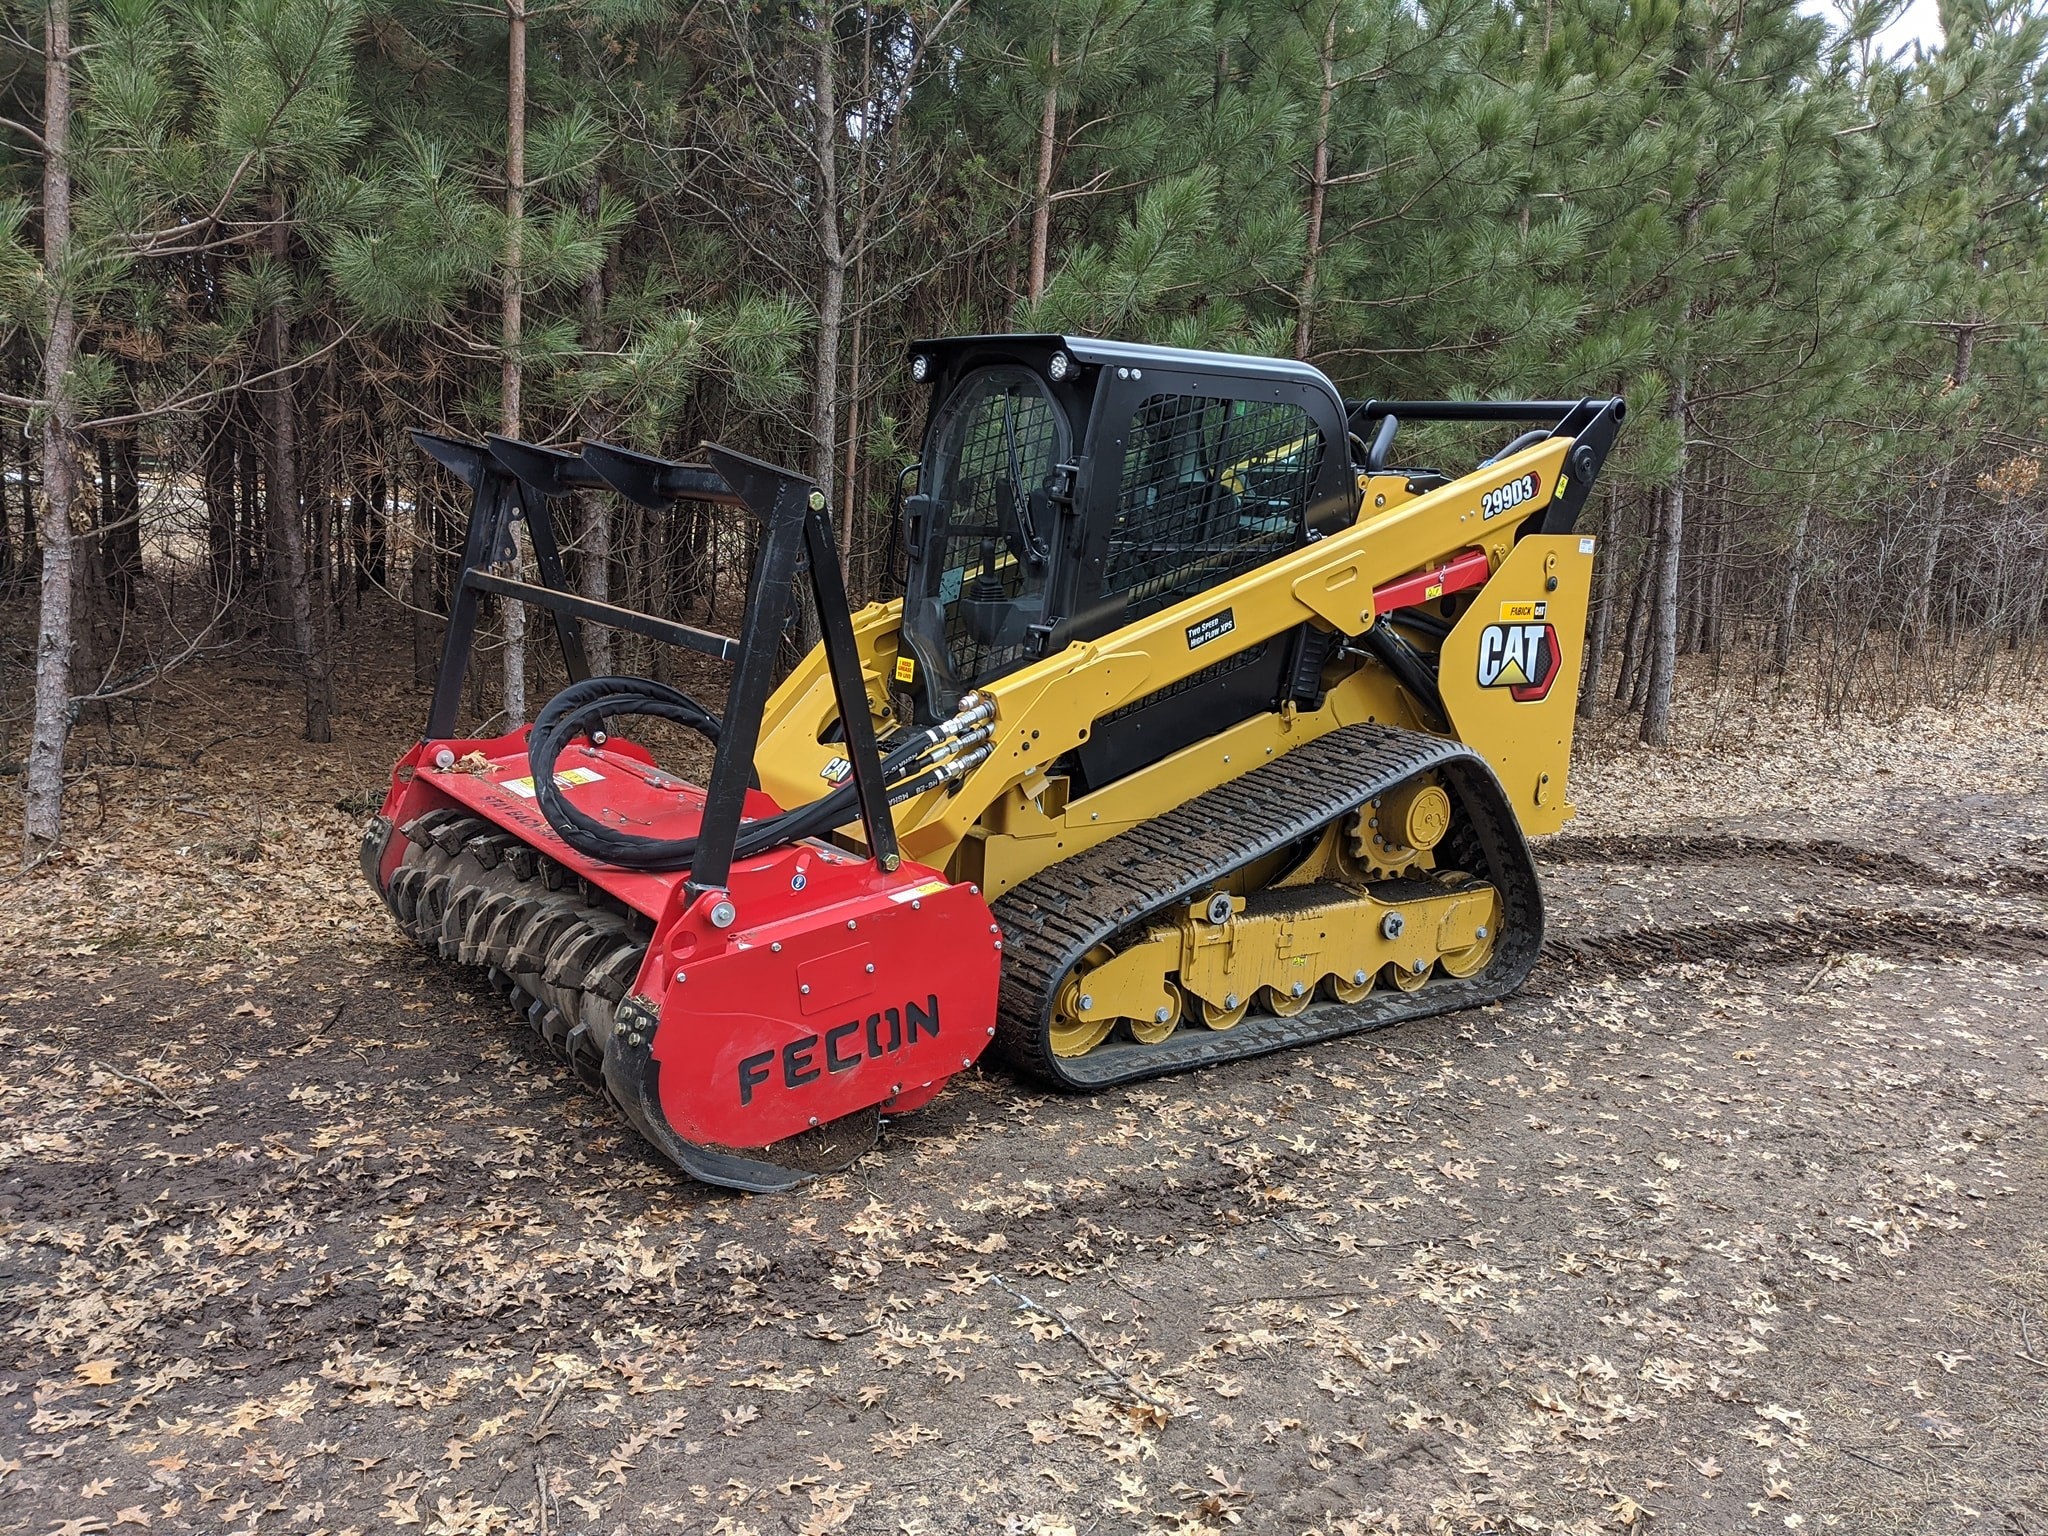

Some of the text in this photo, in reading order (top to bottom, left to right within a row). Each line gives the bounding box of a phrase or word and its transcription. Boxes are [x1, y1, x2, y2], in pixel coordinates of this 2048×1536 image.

[1482, 475, 1533, 520] 299D3
[1220, 620, 1233, 633] XPS
[1510, 606, 1532, 616] FABICK
[1479, 625, 1546, 686] CAT
[821, 757, 852, 783] CAT
[738, 994, 940, 1108] FECON
